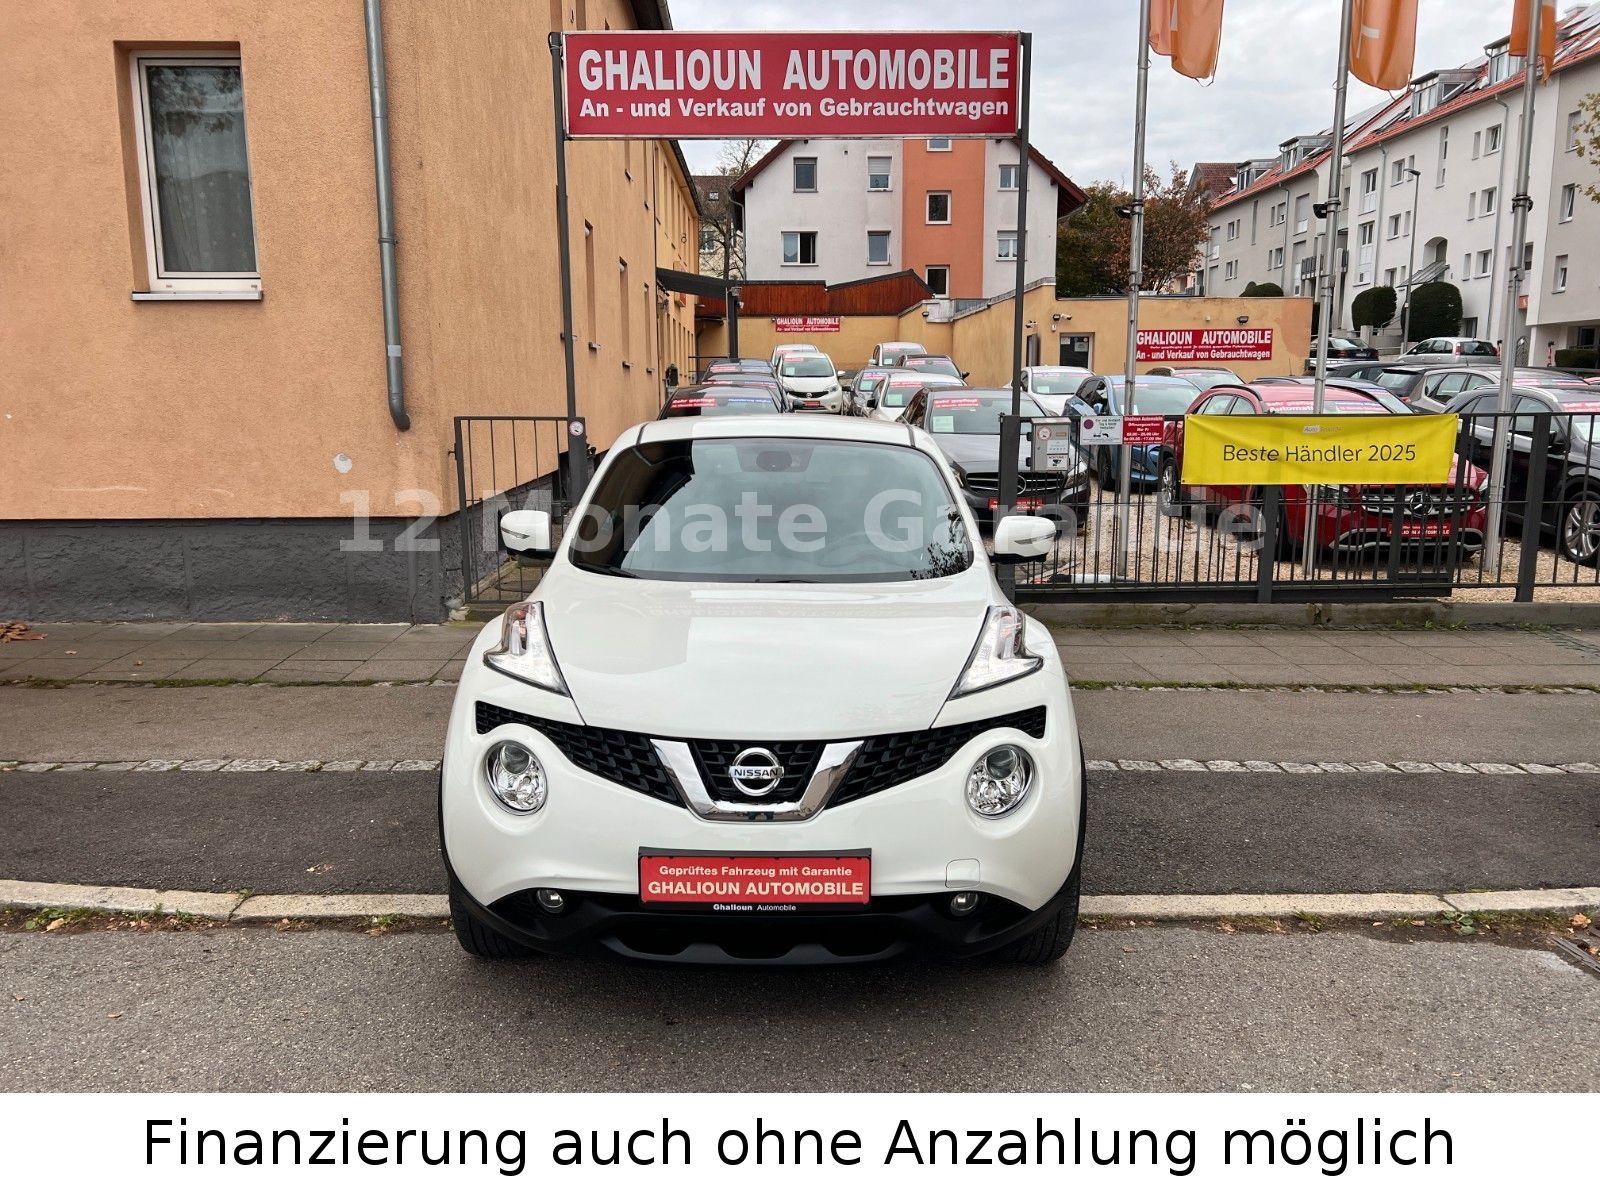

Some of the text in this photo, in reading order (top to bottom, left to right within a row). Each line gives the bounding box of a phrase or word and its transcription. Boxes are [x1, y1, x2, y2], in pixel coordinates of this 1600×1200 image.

[578, 47, 1010, 91] GHALIOUN AUTOMOBILE
[579, 98, 609, 117] An
[630, 98, 671, 117] und
[677, 97, 766, 117] Verkauf
[773, 102, 812, 117] von
[819, 97, 1009, 120] Gebrauchtwagen
[1136, 330, 1272, 345] GHALIOUN AUTOMOBILE
[1152, 350, 1165, 360] und
[1167, 349, 1195, 360] Verkauf
[1196, 351, 1209, 359] von
[1210, 349, 1271, 360] Gebrauchtwagen
[1223, 444, 1416, 462] Beste Händler 2025
[734, 768, 778, 777] NISSAN
[659, 865, 852, 877] Geprüftes Fahrzeug mit Garantie
[648, 881, 864, 895] GHALIOUN AUTOMOBILE
